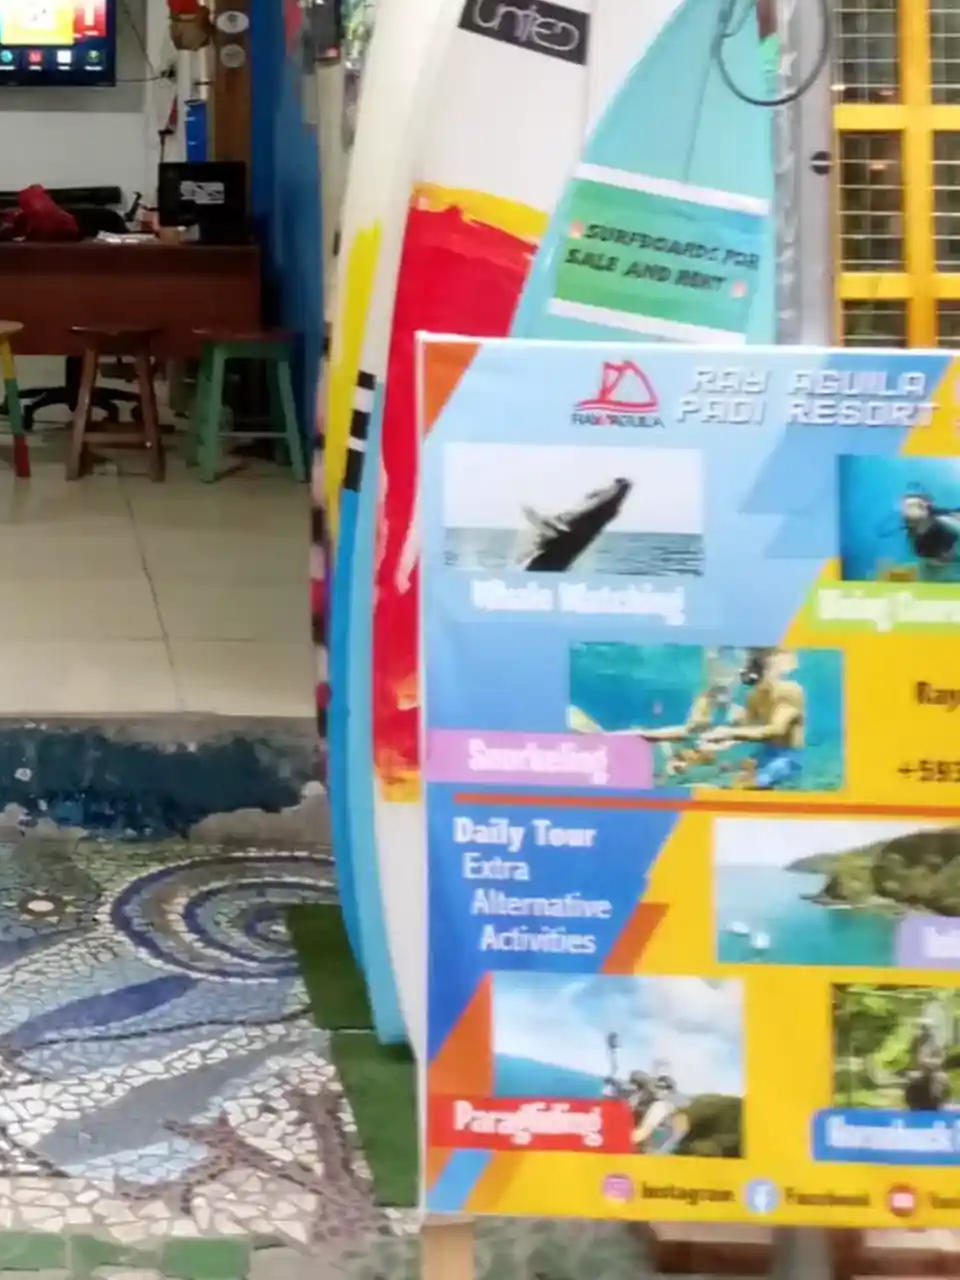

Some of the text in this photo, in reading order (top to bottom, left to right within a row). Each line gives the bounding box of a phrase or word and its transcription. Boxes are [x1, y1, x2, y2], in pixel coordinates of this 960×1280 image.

[565, 248, 620, 272] SALE
[622, 260, 672, 282] AND
[453, 816, 596, 852] Daily Tour
[463, 853, 530, 880] Extra
[471, 888, 612, 919] Alternative
[481, 924, 596, 954] Activities
